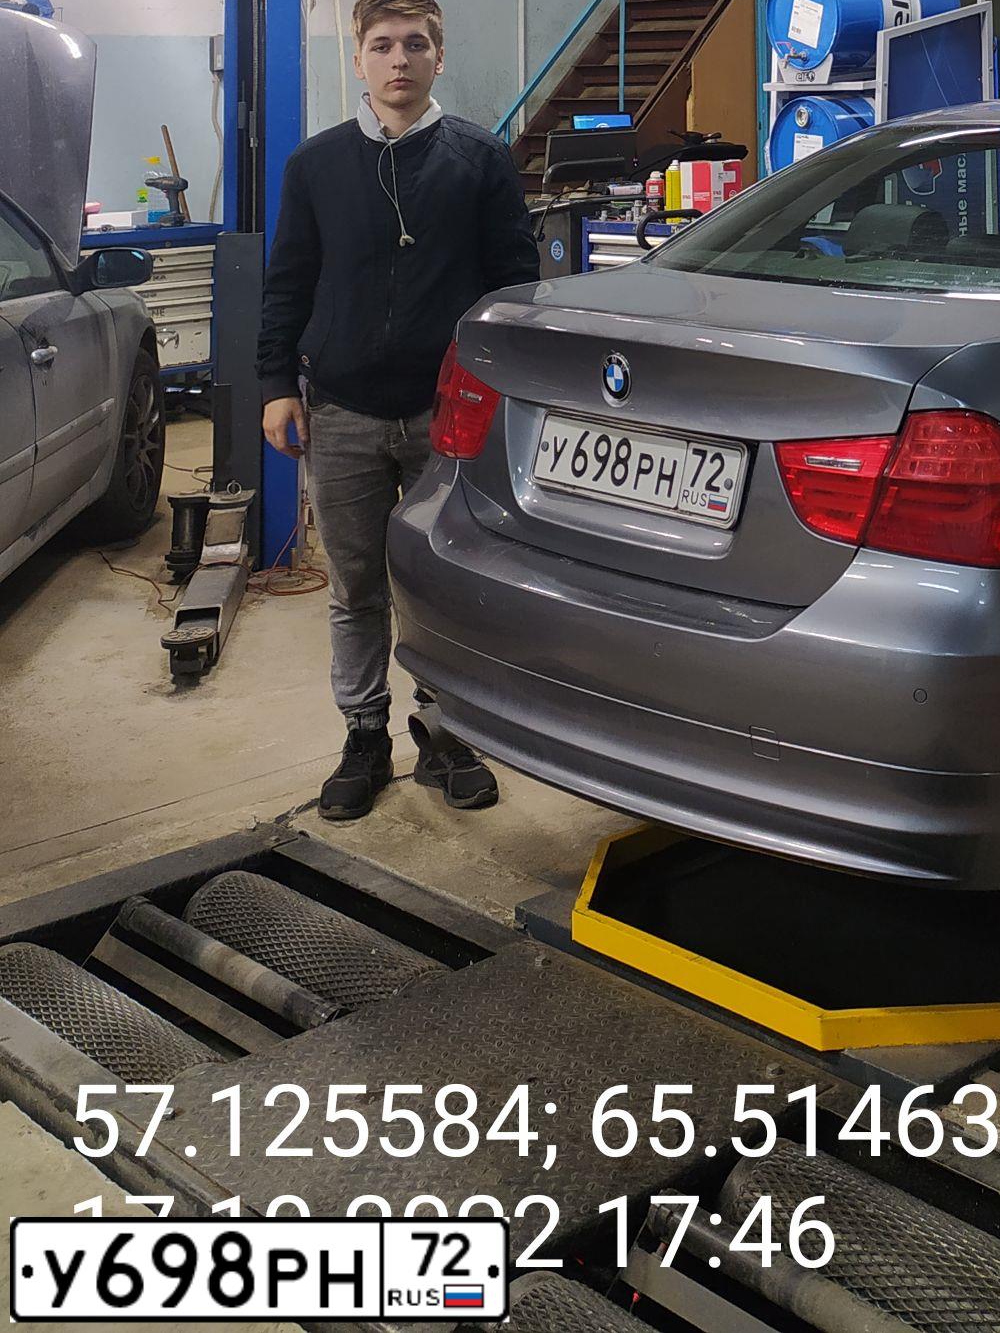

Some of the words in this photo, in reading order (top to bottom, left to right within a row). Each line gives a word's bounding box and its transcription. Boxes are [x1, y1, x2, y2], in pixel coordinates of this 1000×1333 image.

[957, 153, 967, 193] мас
[550, 430, 678, 498] У698РН
[689, 448, 725, 493] 72
[681, 489, 707, 507] RUS
